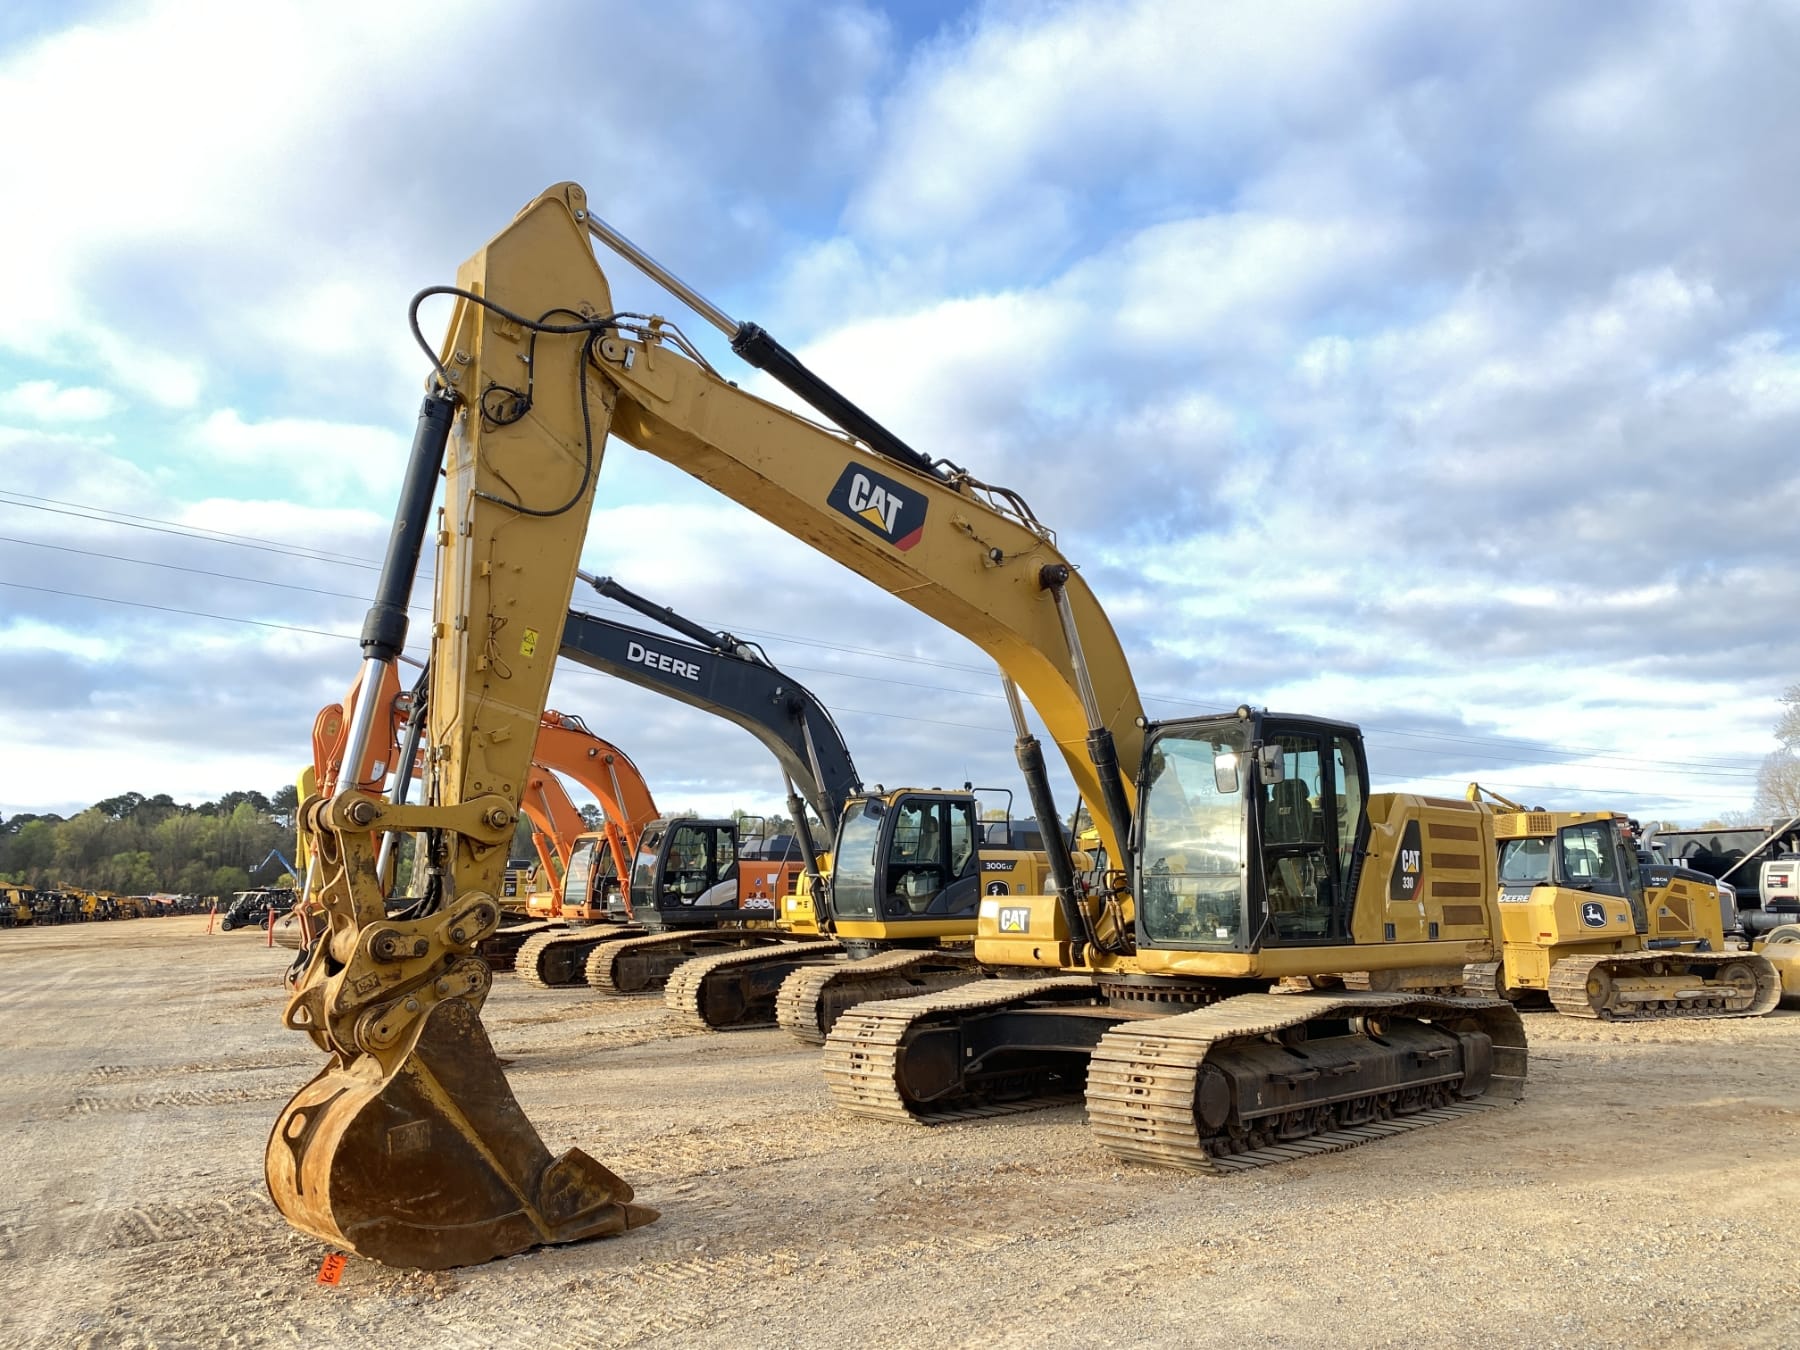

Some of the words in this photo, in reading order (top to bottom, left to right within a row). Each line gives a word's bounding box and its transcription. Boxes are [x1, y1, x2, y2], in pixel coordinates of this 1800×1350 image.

[848, 473, 903, 535] CAT
[627, 641, 701, 681] DEERE
[1401, 849, 1420, 873] CAT
[1402, 876, 1414, 889] 330
[743, 898, 770, 910] 300
[1499, 893, 1530, 903] DEERE
[1001, 909, 1028, 931] CAT
